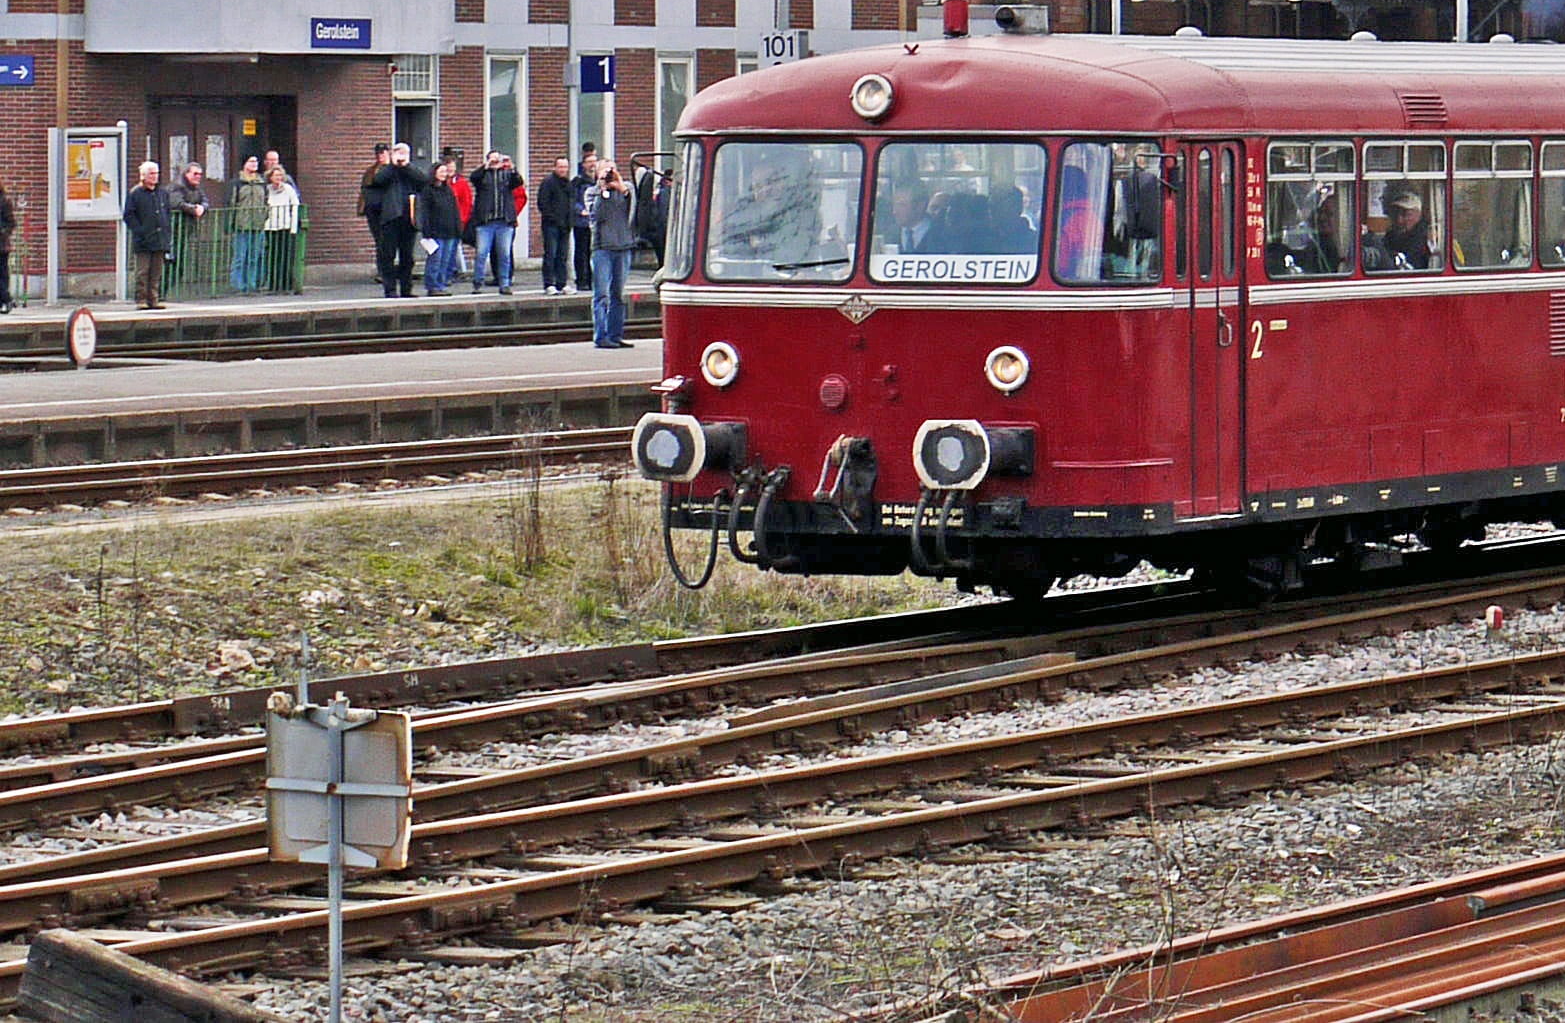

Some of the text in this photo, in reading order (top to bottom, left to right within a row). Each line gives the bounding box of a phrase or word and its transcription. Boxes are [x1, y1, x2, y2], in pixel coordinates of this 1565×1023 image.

[316, 22, 360, 40] Gerolstein
[763, 35, 794, 58] 101
[598, 57, 609, 84] 1
[883, 259, 1030, 279] GEROLSTEIN
[1251, 320, 1263, 359] 2
